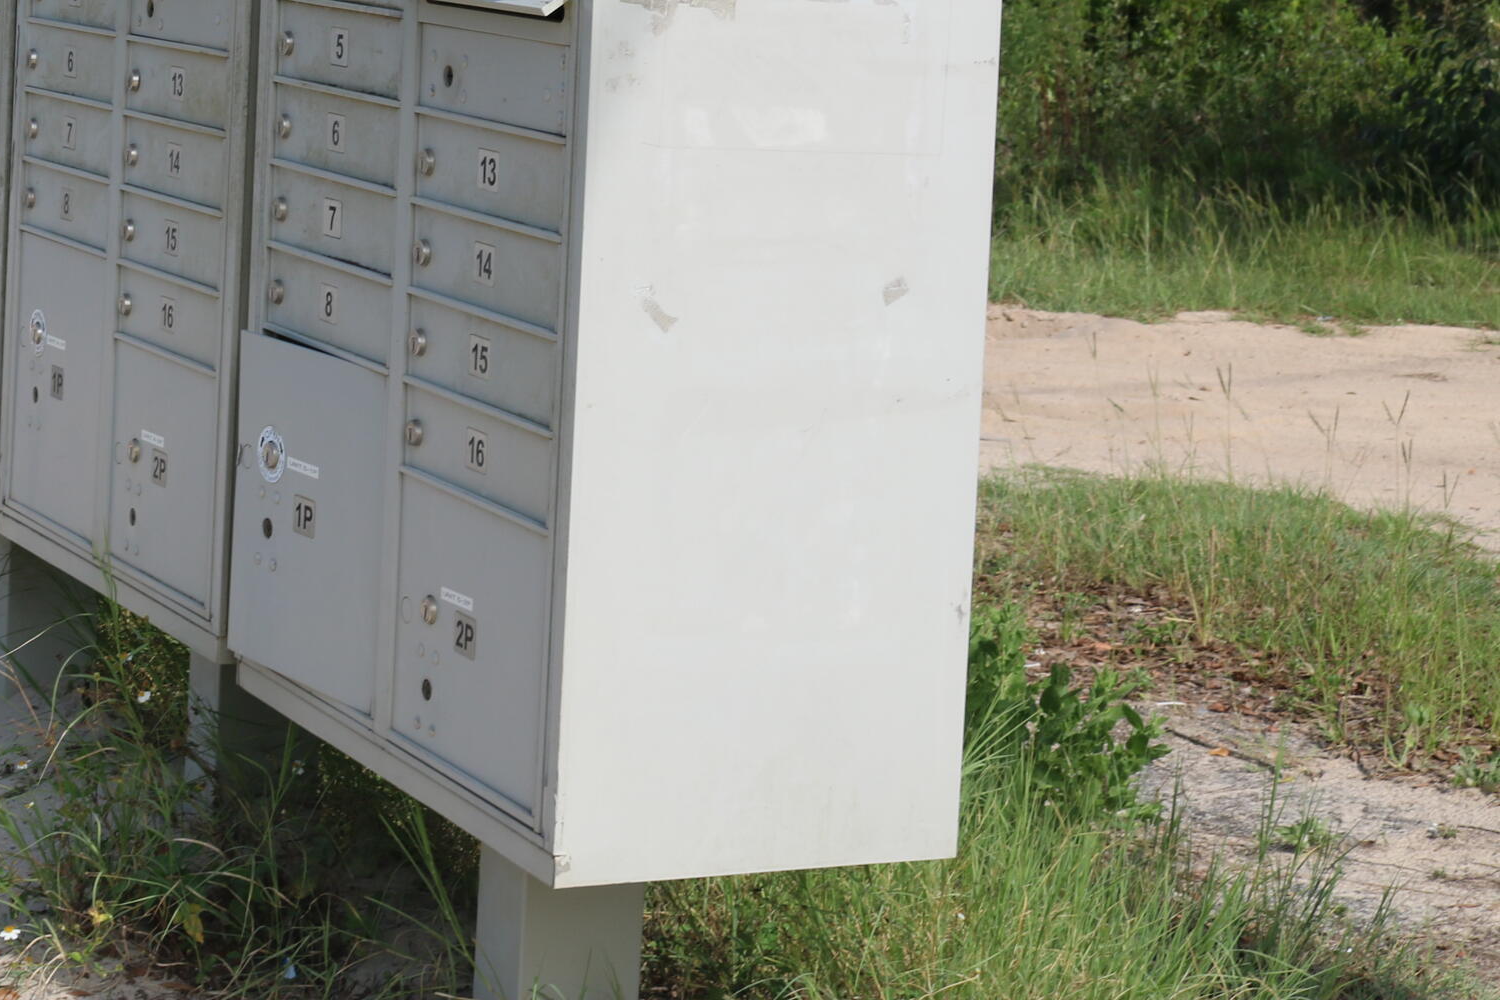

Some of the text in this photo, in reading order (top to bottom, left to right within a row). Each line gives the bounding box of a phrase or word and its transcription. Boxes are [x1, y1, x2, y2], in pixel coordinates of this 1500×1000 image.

[335, 33, 344, 60] 5
[67, 50, 74, 73] 6
[171, 72, 184, 97] 13
[67, 122, 73, 143] 7
[331, 120, 340, 146] 6
[169, 149, 181, 174] 14
[480, 156, 497, 187] 13
[63, 192, 70, 215] 8
[328, 205, 337, 231] 7
[165, 226, 177, 251] 15
[476, 249, 493, 280] 14
[161, 303, 174, 329] 16
[324, 291, 333, 317] 8
[471, 343, 489, 374] 15
[52, 372, 64, 394] 1P
[468, 436, 485, 468] 16
[152, 456, 166, 481] 2P
[295, 502, 313, 530] 1P
[455, 620, 474, 651] 2P
